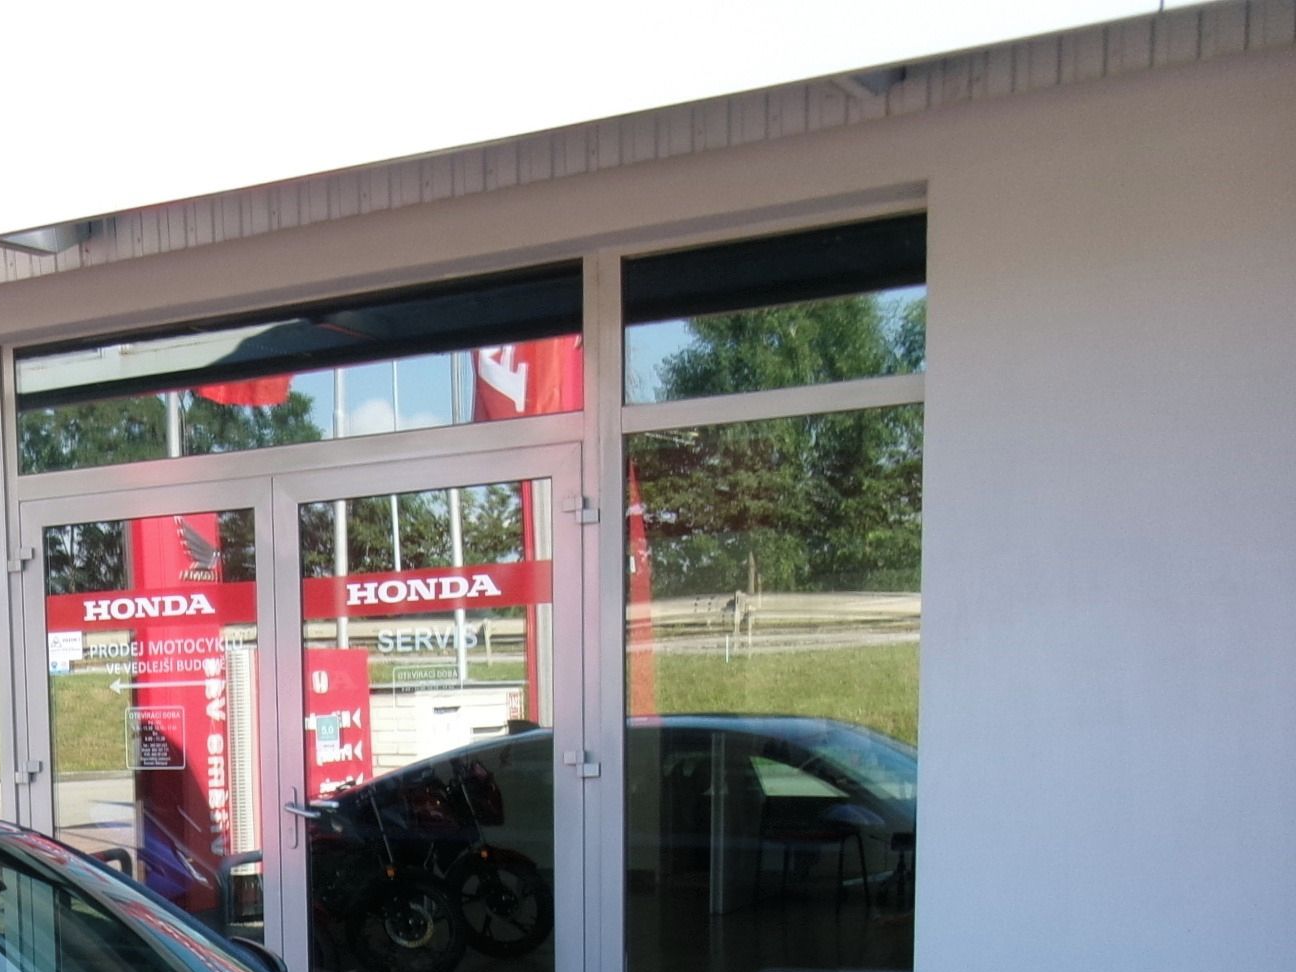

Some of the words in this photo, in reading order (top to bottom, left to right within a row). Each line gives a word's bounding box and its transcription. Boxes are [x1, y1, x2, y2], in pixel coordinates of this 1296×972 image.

[347, 574, 502, 606] HONDA
[83, 593, 215, 622] HONDA
[91, 640, 144, 659] PRODEJ
[378, 623, 478, 653] SERVIS
[106, 662, 122, 675] VE
